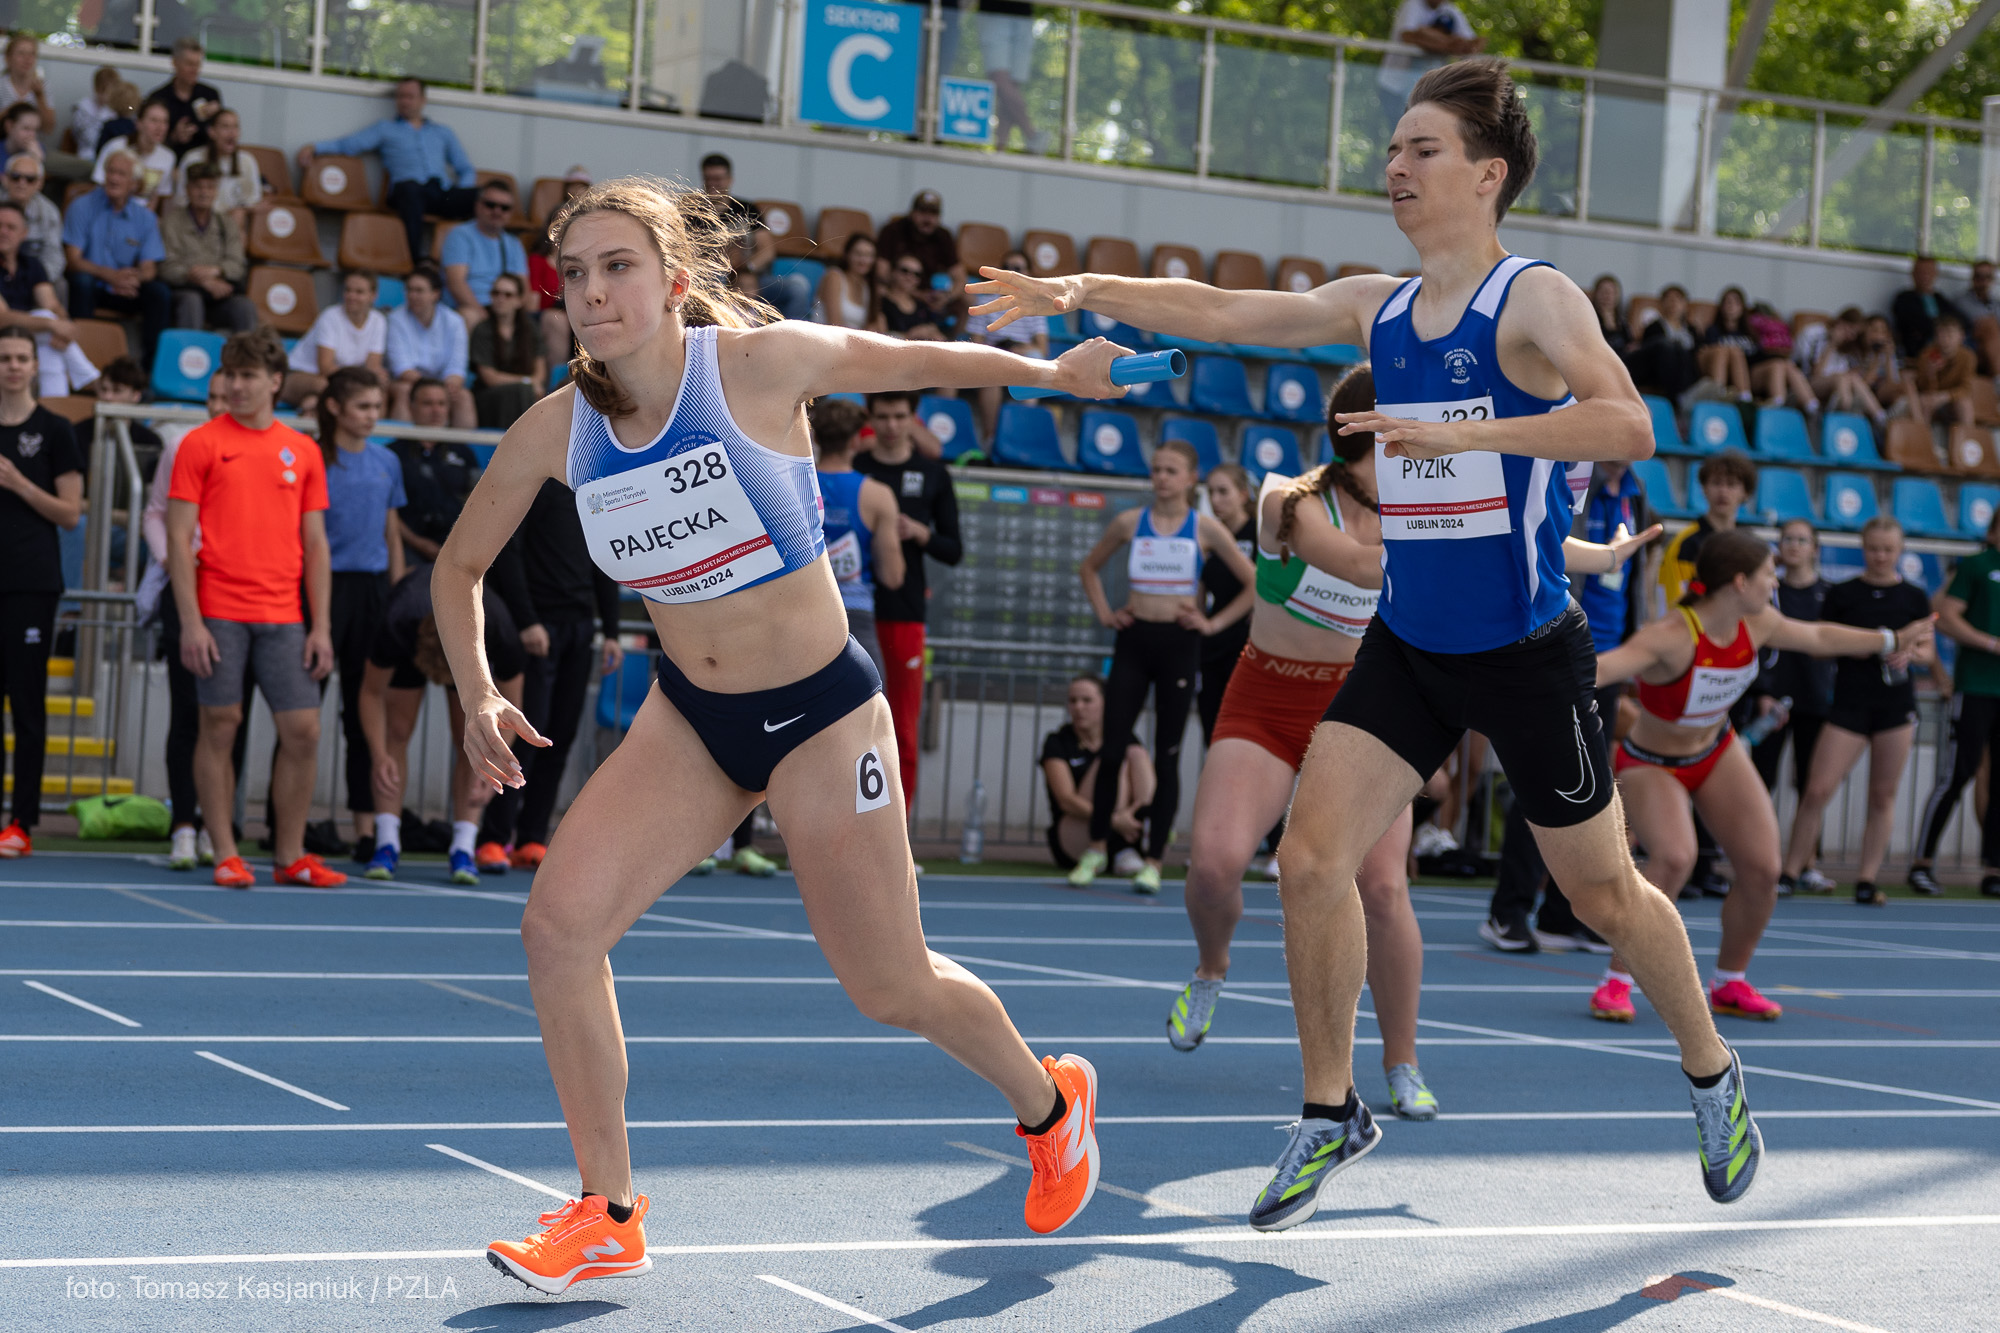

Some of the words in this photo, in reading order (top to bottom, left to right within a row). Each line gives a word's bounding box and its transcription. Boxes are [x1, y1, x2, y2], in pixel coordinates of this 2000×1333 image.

[825, 4, 900, 33] SEKTOR
[827, 33, 893, 121] C
[944, 84, 989, 119] WC
[664, 452, 727, 494] 328
[1402, 457, 1457, 479] PYZIK
[602, 485, 634, 498] Ministerstwo
[604, 497, 621, 506] Sportu
[623, 489, 647, 501] Turystyki
[1466, 500, 1504, 510] MIESZANYCH
[609, 507, 729, 561] PAJĘCKA
[1406, 519, 1439, 530] LUBLIN
[1440, 518, 1465, 529] 2024
[668, 572, 686, 582] POLSKI
[692, 554, 730, 574] SZTAFETACH
[729, 538, 768, 558] MIESZANYCH
[661, 582, 702, 597] LUBLIN
[701, 567, 734, 589] 2024
[1264, 660, 1337, 681] NIKE
[860, 752, 883, 800] 6
